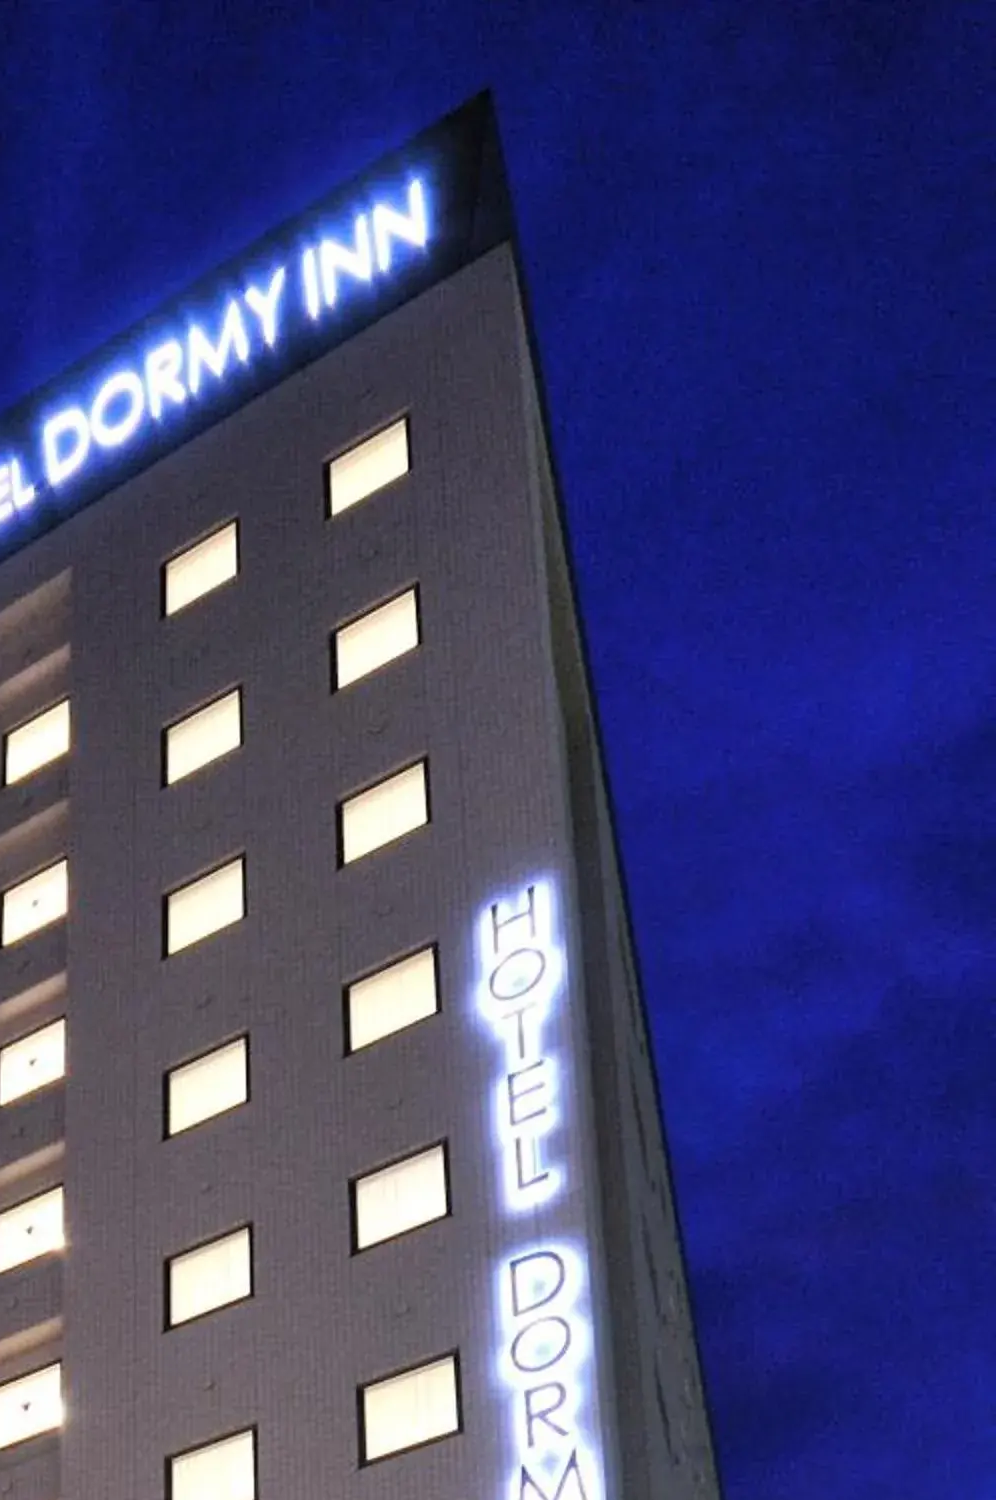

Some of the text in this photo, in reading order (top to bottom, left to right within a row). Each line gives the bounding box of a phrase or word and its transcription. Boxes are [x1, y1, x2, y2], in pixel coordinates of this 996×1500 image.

[43, 268, 285, 486] DORMY
[302, 178, 429, 321] INN
[489, 885, 550, 1191] HOTEL
